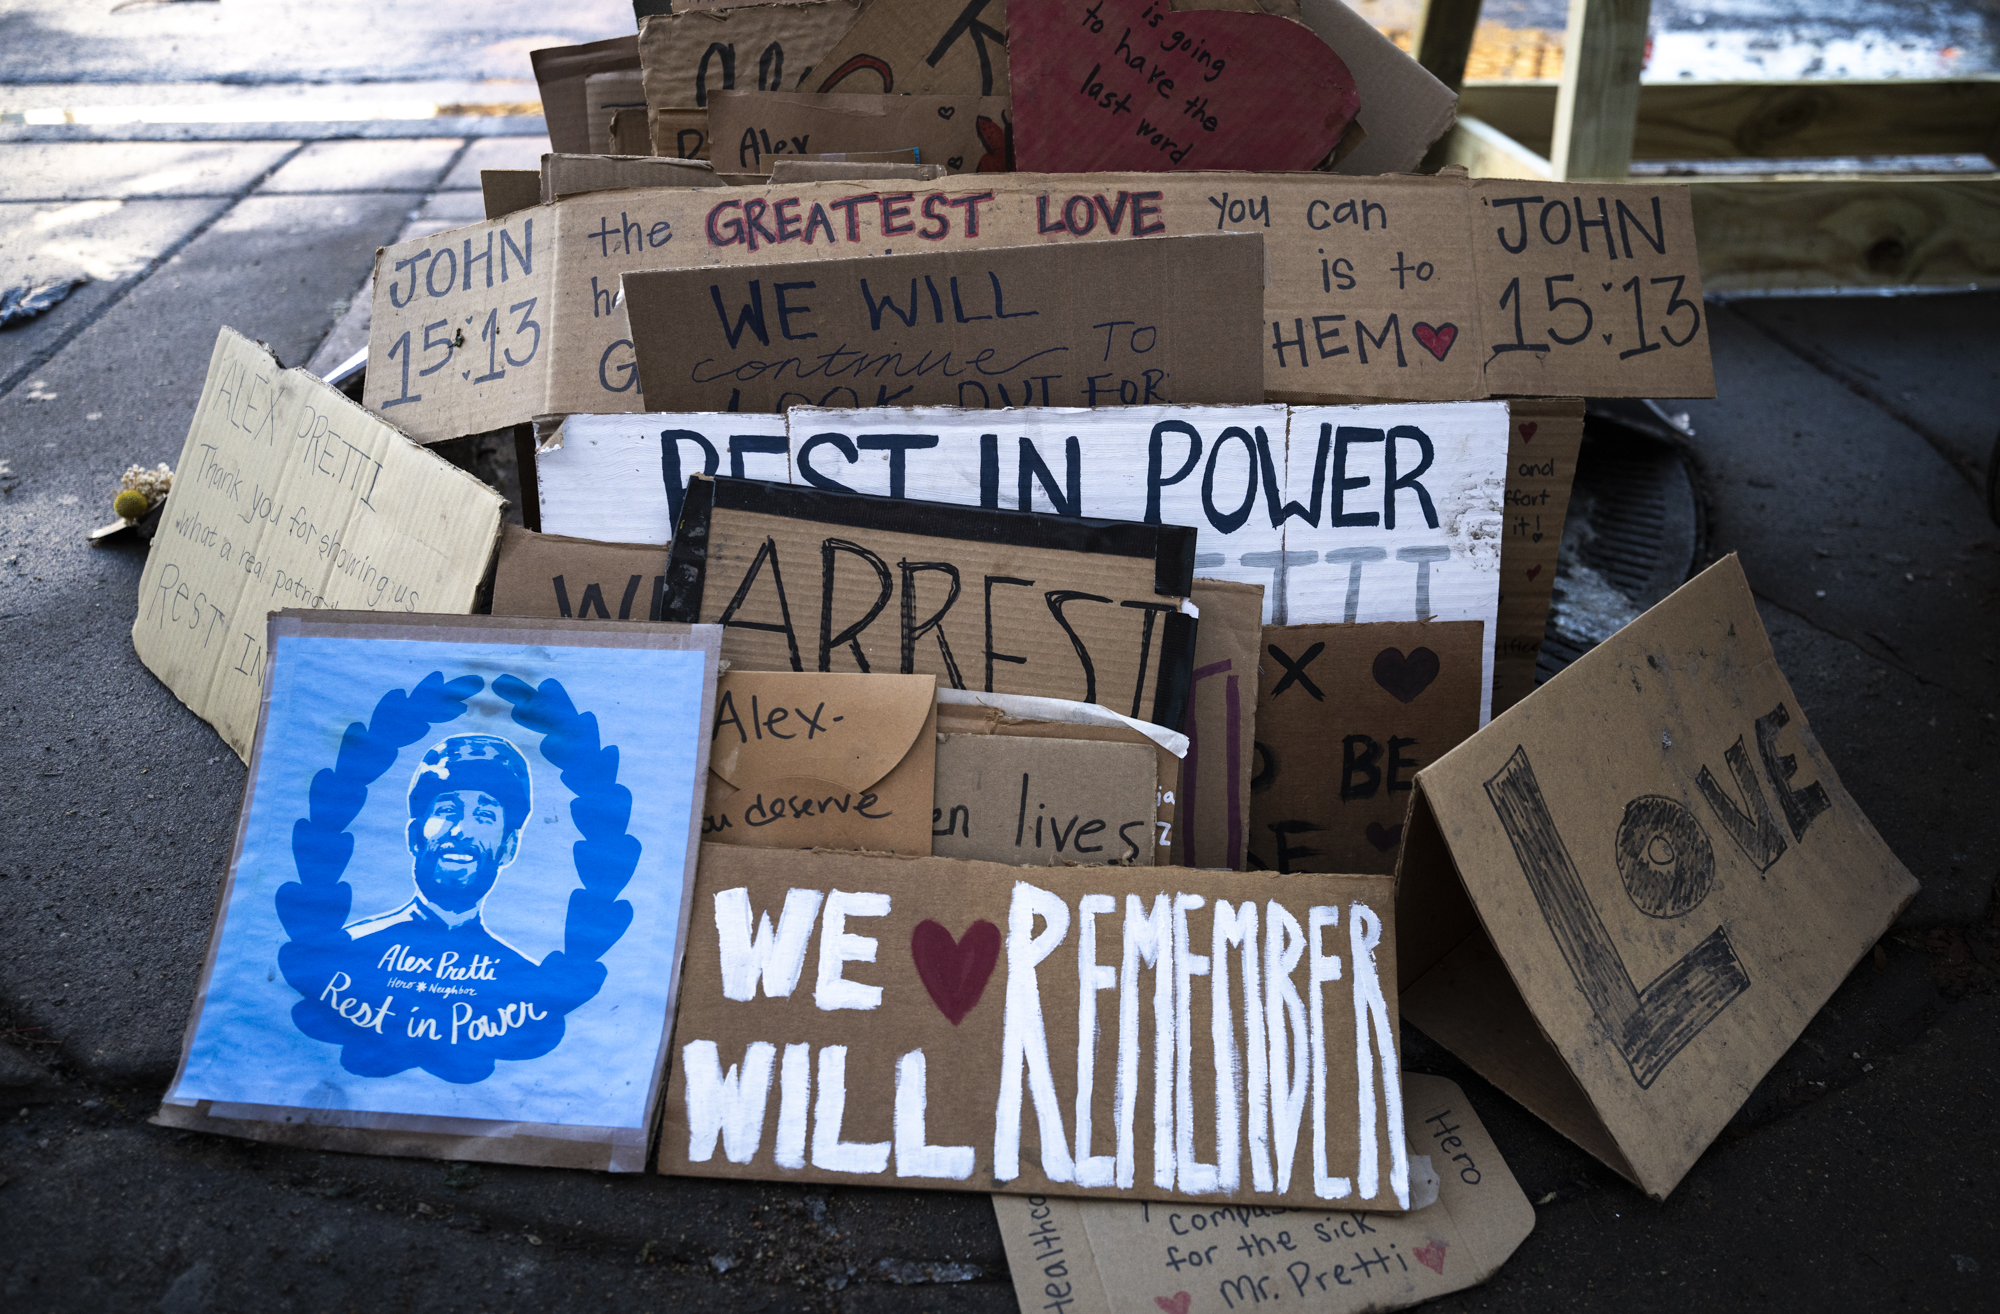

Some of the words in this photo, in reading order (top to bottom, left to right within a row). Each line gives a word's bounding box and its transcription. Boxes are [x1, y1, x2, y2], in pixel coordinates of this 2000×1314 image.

[1081, 2, 1105, 34] to
[1114, 28, 1175, 98] have
[1184, 96, 1219, 132] the
[1142, 1, 1164, 28] is
[1161, 31, 1226, 82] going
[1080, 63, 1132, 116] last
[1136, 118, 1194, 165] word
[588, 211, 672, 258] the
[704, 190, 995, 253] GREATEST
[1036, 190, 1165, 238] LOVE
[1307, 199, 1387, 231] can
[1492, 196, 1666, 260] JOHN
[389, 218, 533, 309] JOHN
[1318, 248, 1357, 293] is
[1390, 252, 1434, 290] to
[710, 280, 818, 350] WE
[860, 271, 1039, 331] WILL
[1272, 313, 1408, 368] HEM
[1492, 273, 1701, 361] 15:13
[381, 296, 541, 409] 15:13
[691, 342, 1069, 385] continue
[1093, 321, 1156, 361] TO
[213, 359, 285, 446] ALEX
[292, 404, 384, 513] PRETTI
[1518, 458, 1554, 477] and
[980, 433, 1082, 518] IN
[1144, 419, 1439, 535] POWER
[197, 443, 244, 502] Thank
[238, 484, 284, 524] you
[290, 507, 319, 545] for
[318, 532, 390, 607] showing
[394, 586, 420, 613] us
[220, 540, 232, 562] a
[239, 546, 270, 583] real
[271, 569, 338, 610] patrio
[234, 633, 268, 687] IN
[717, 535, 1178, 719] ARREST
[1341, 734, 1420, 804] BE
[744, 792, 893, 826] deserve
[1015, 772, 1145, 865] lives
[1483, 702, 1832, 1091] LOVE
[376, 943, 433, 974] Alex
[436, 951, 501, 982] Pretti
[713, 886, 892, 1011] WE
[319, 971, 396, 1035] Rest
[407, 1005, 442, 1041] in
[451, 1001, 548, 1045] Power
[387, 977, 416, 990] Hero
[428, 983, 478, 999] Neighbor
[992, 879, 1411, 1211] REMEMBER
[682, 1039, 975, 1181] WILL
[1424, 1108, 1483, 1186] Hero
[1166, 1245, 1218, 1272] for
[1237, 1231, 1298, 1258] the
[1314, 1211, 1377, 1243] sick
[1220, 1274, 1280, 1309] Mr.
[1285, 1243, 1409, 1298] Pretti
